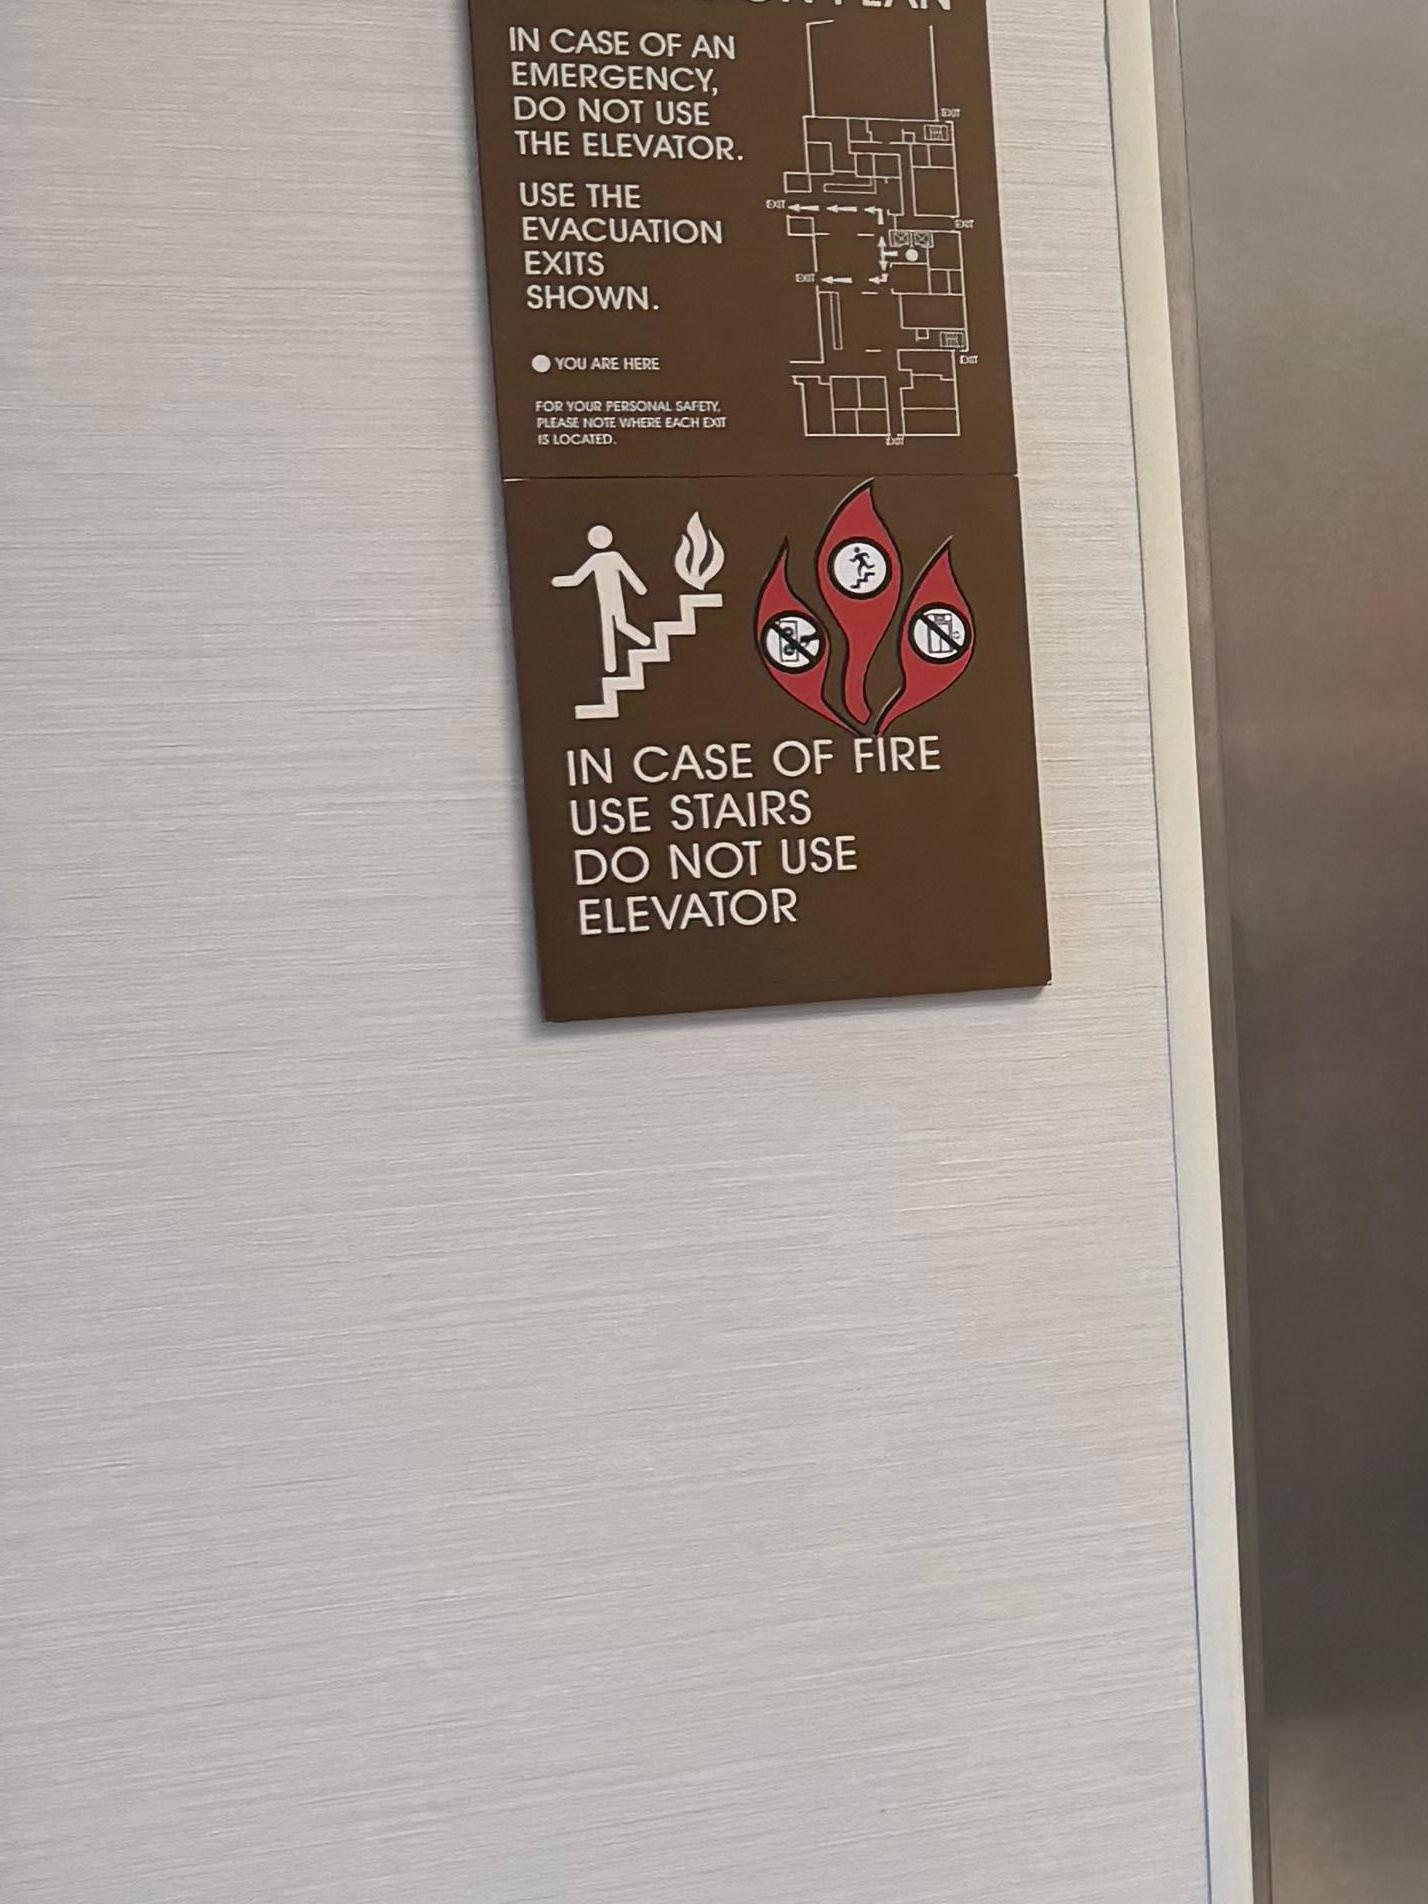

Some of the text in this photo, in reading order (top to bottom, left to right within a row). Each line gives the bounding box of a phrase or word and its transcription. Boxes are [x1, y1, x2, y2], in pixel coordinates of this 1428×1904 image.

[509, 27, 736, 60] IN CASE OF AN
[511, 62, 719, 97] EMERGENCY,
[513, 97, 710, 126] DO NOT USE
[515, 132, 744, 162] THE ELEVATOR.
[519, 183, 641, 208] USE THE
[522, 218, 723, 244] EVACUATION
[525, 252, 605, 276] EXITS
[526, 286, 659, 310] SHOWN.
[554, 357, 660, 370] YOU ARE HERE
[535, 400, 563, 412] FOR
[566, 400, 602, 412] YOUR
[605, 400, 672, 412] PERSONAL
[537, 417, 727, 429] PLEASE NOTE WHERE EACH EXIT
[538, 434, 617, 445] IS LOCATED.
[567, 734, 941, 786] IN CASE OF FIRE
[569, 789, 812, 836] USE STAIRS
[574, 836, 857, 887] DO NOT USE
[579, 888, 797, 936] ELEVATOR
